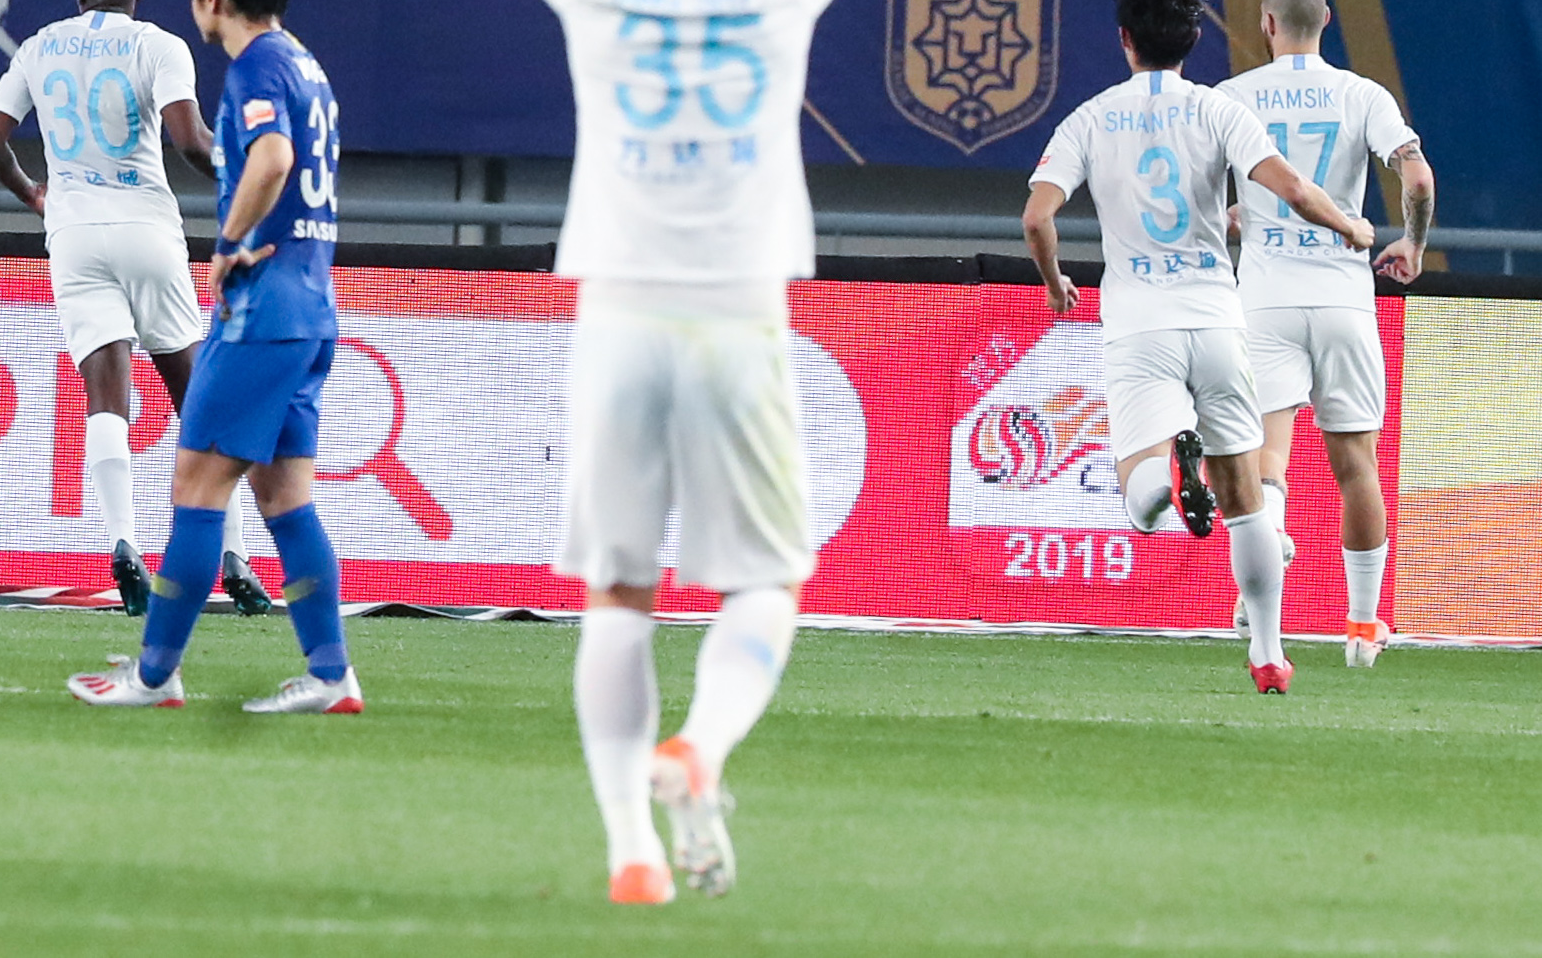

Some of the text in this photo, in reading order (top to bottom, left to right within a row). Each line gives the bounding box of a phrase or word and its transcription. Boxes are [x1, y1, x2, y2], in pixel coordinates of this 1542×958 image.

[43, 67, 140, 161] 30
[616, 13, 767, 129] 35
[1256, 86, 1335, 111] HAMSIK
[1137, 145, 1190, 243] 3
[1267, 121, 1340, 218] 17
[1004, 532, 1136, 580] 2019
